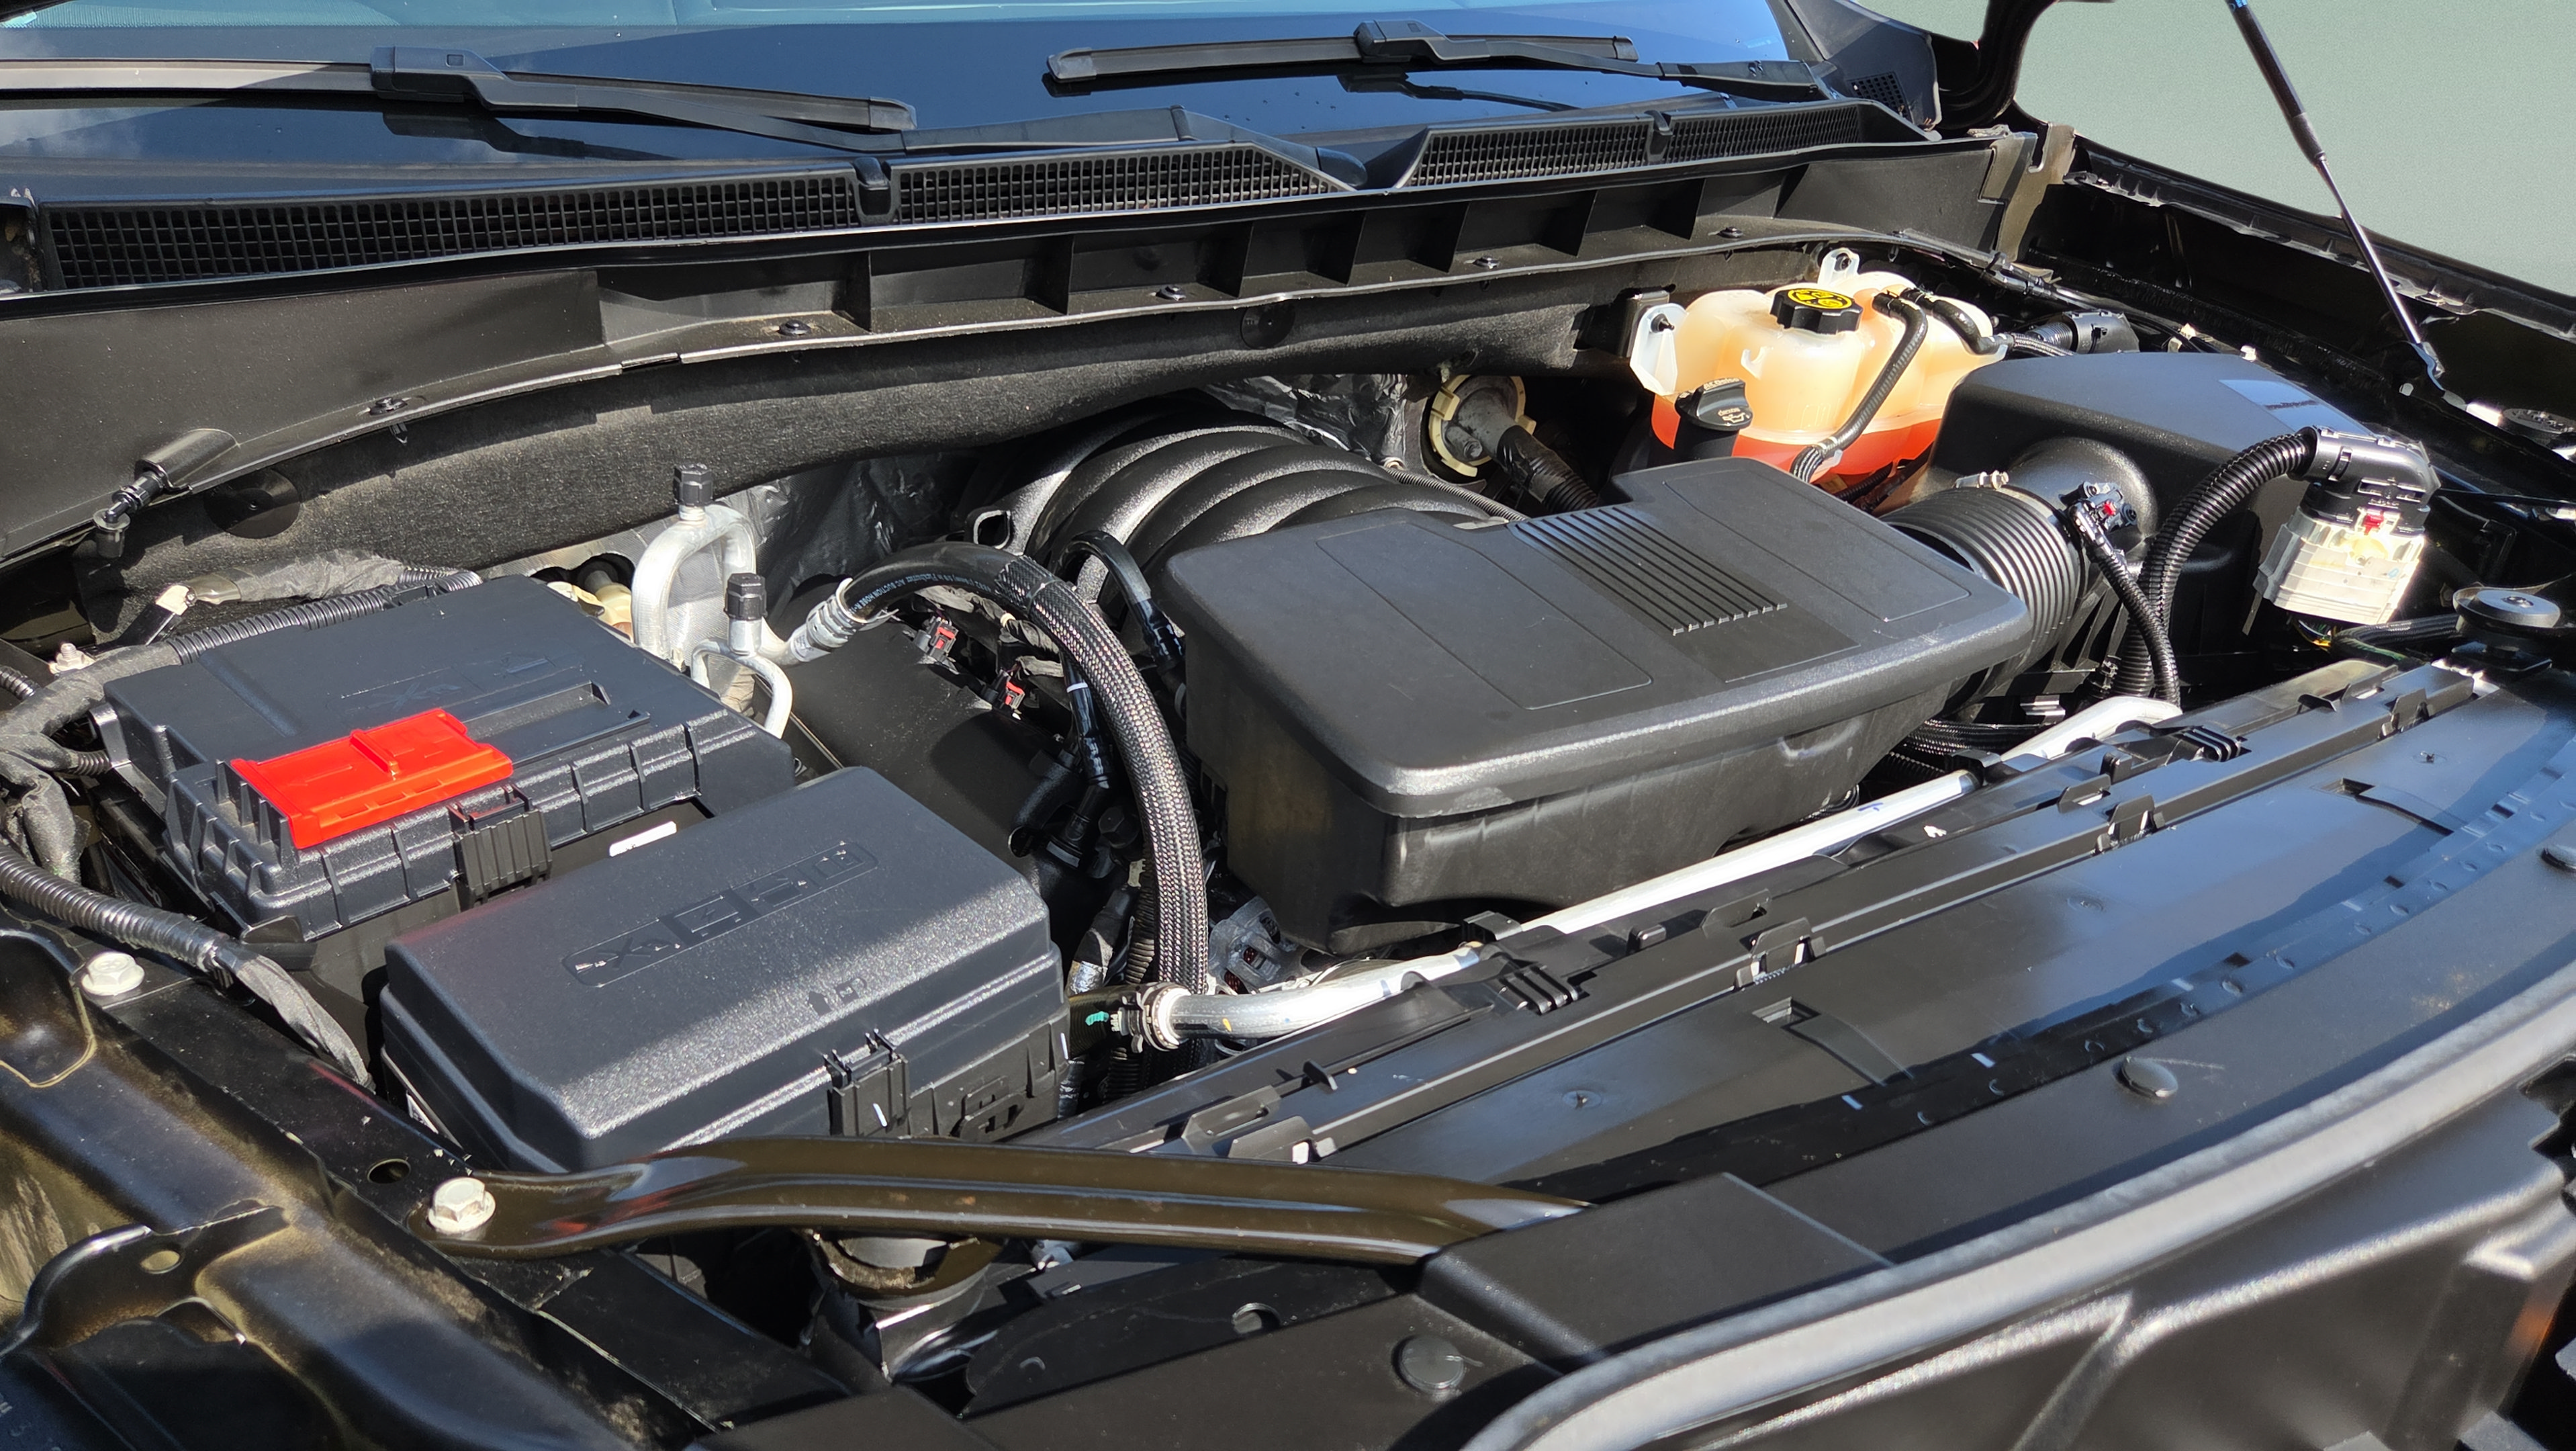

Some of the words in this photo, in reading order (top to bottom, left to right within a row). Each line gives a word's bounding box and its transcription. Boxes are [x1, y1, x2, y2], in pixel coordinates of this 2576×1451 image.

[1703, 378, 1740, 390] ACDelco
[872, 582, 896, 597] SUCTION
[859, 592, 876, 607] HOSE
